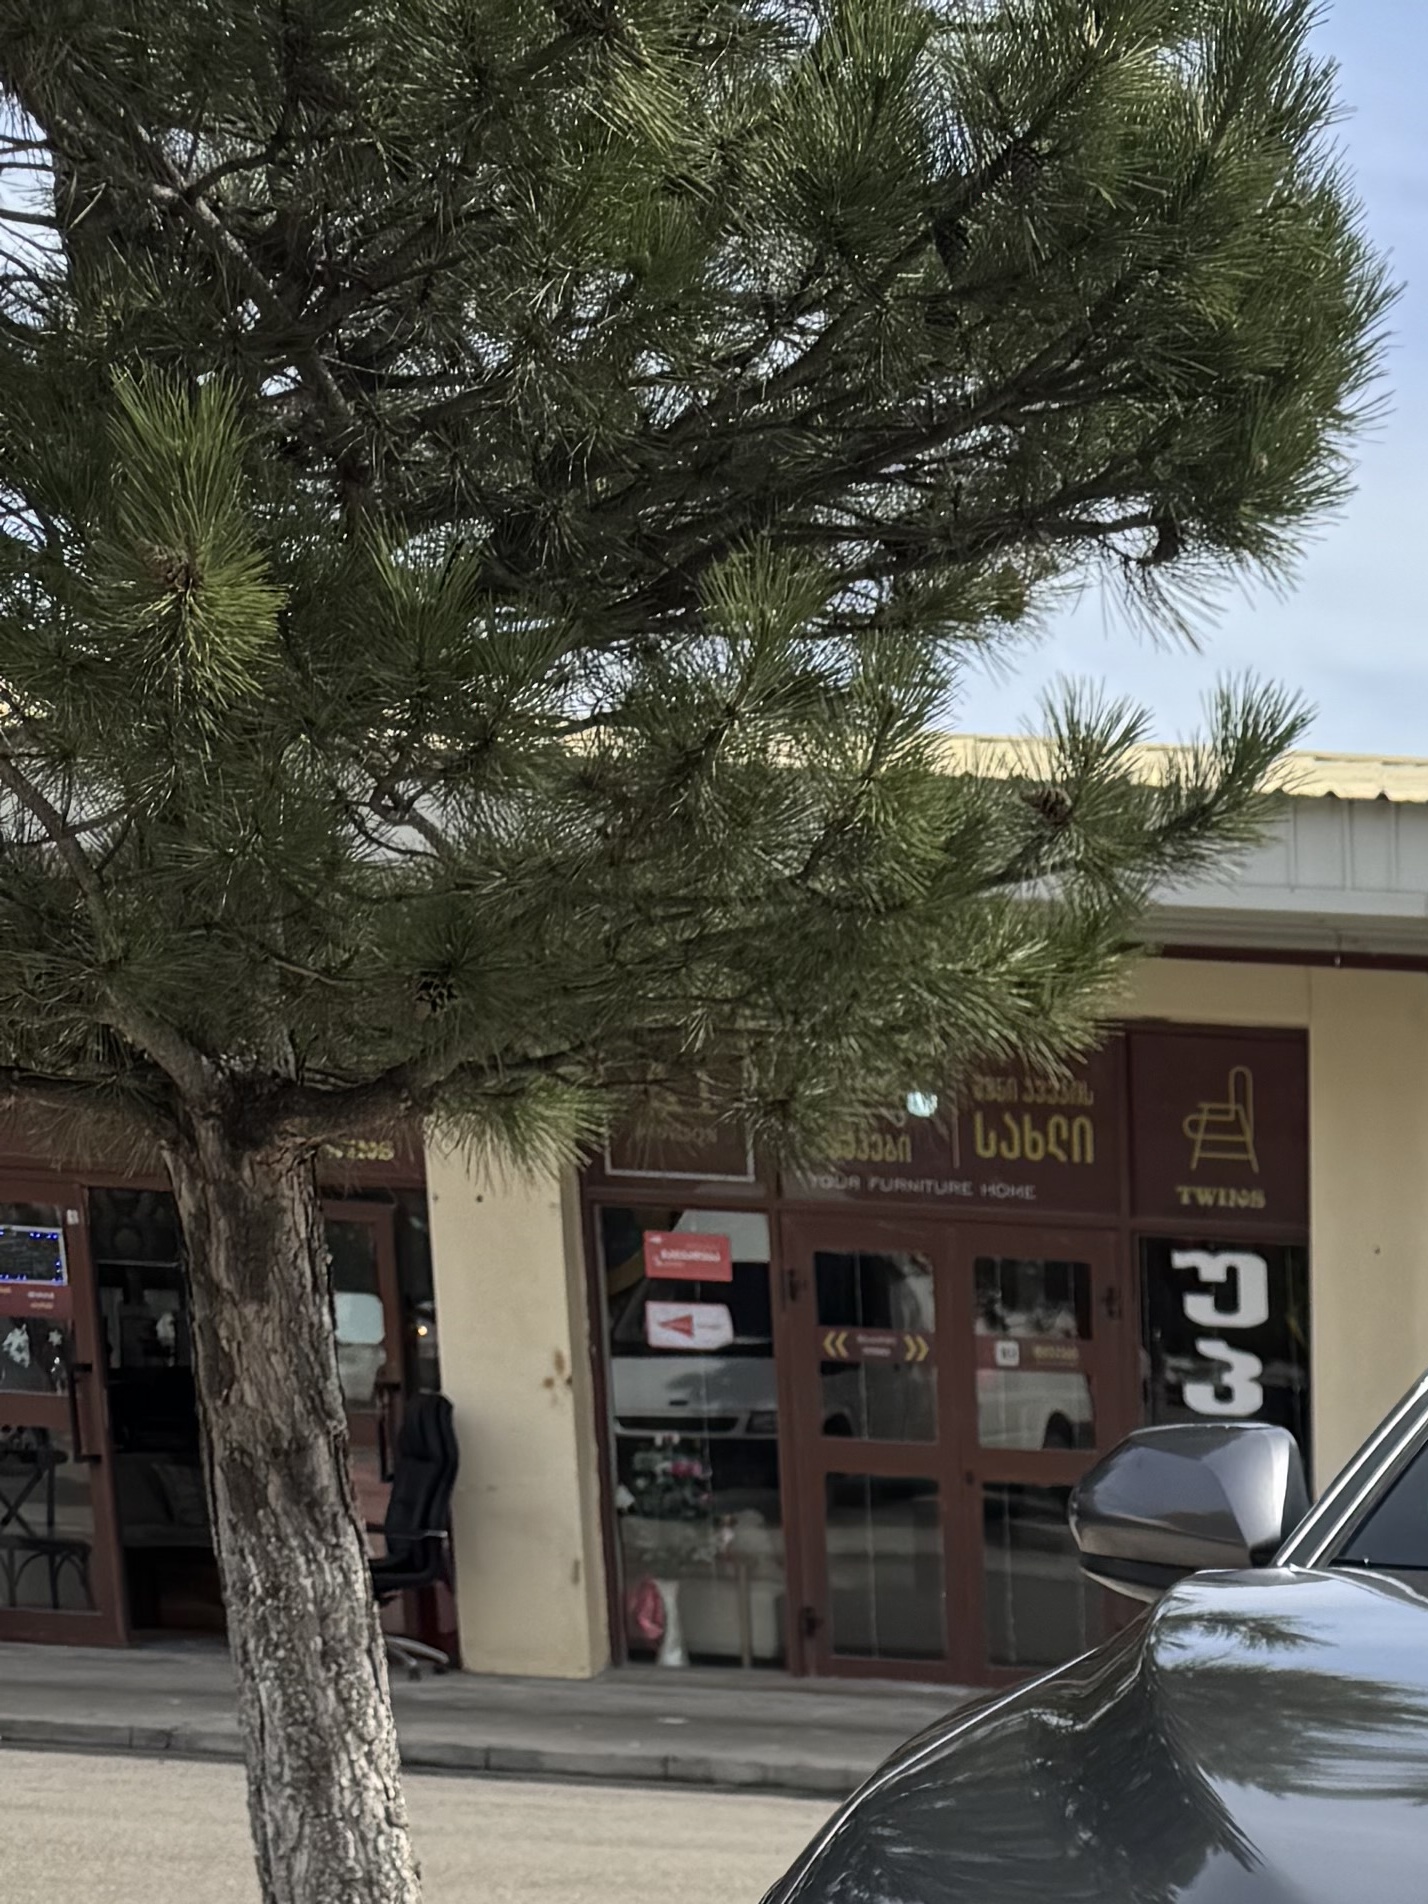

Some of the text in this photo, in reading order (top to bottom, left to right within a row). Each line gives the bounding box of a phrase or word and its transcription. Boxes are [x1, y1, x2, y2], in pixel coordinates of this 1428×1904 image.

[973, 1111, 1095, 1165] სახლი
[808, 1173, 1037, 1201] YOUR FURNITURE HOME
[1175, 1185, 1267, 1209] TWINS
